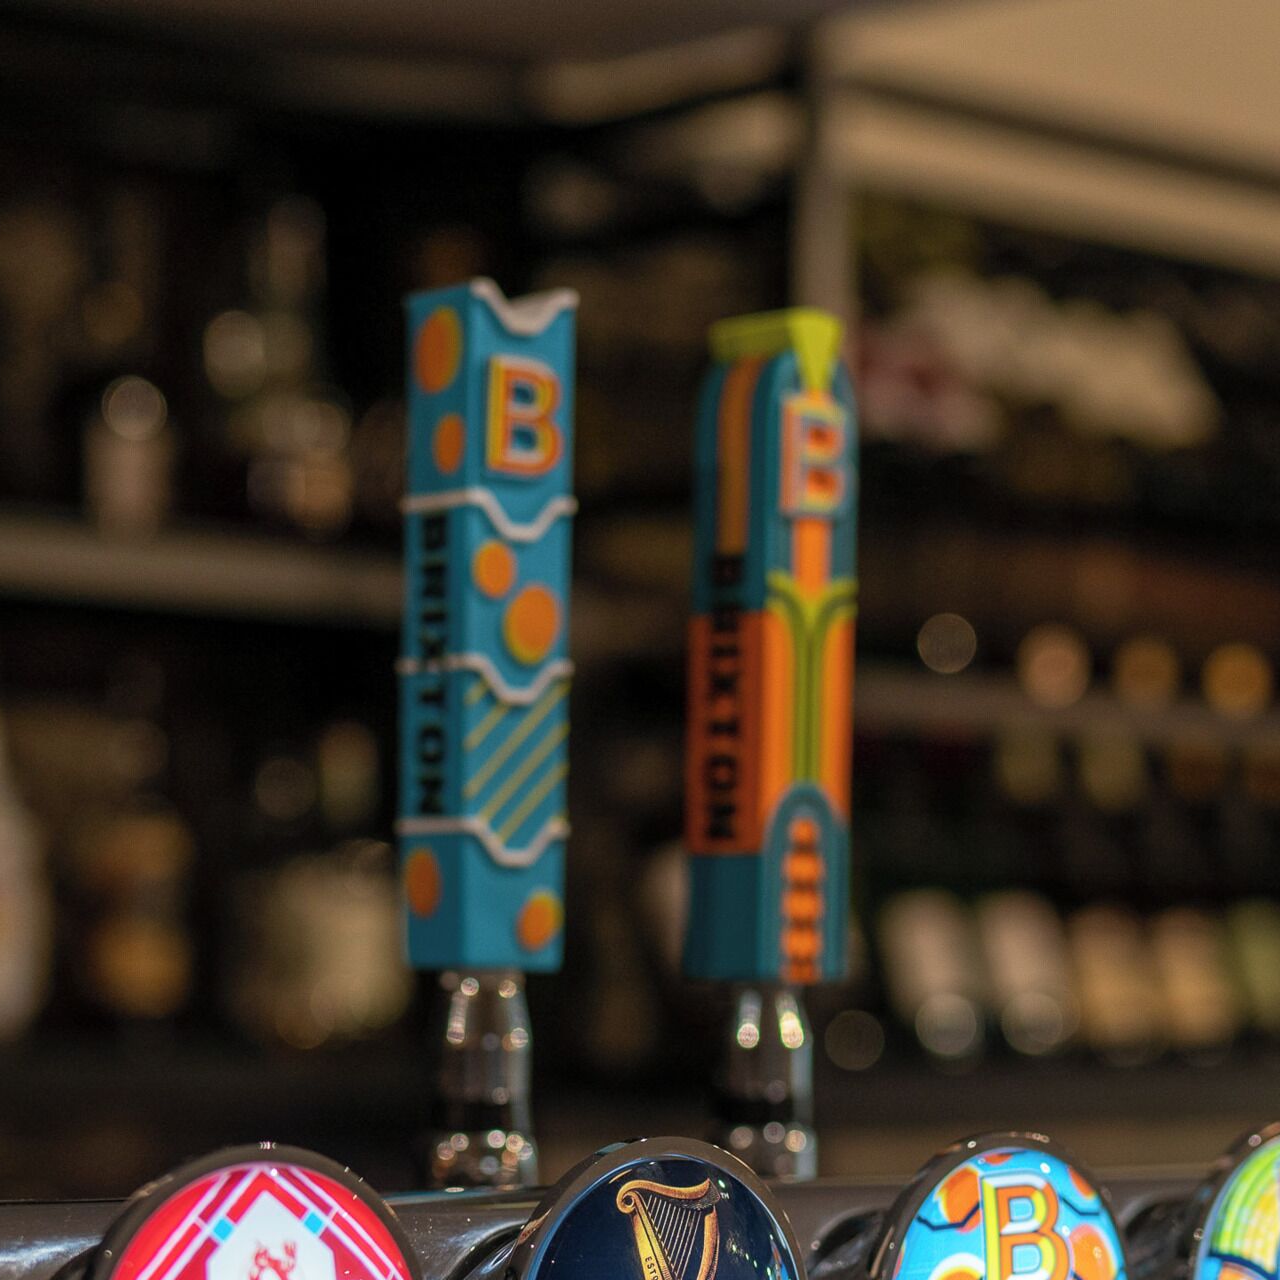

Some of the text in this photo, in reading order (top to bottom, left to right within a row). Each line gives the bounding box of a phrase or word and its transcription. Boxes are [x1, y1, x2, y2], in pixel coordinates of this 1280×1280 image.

[485, 354, 564, 476] B
[417, 513, 449, 816] BRIXTON
[706, 554, 743, 841] BRIXTON
